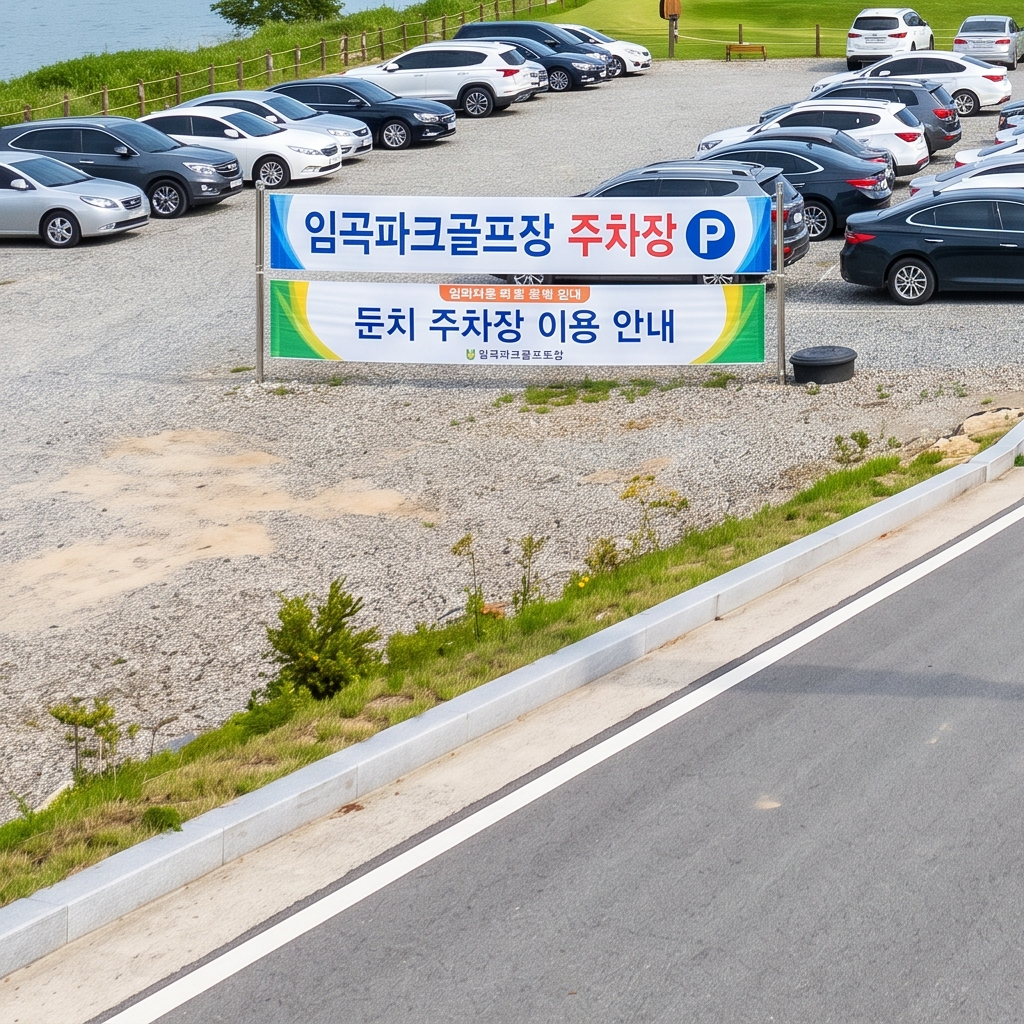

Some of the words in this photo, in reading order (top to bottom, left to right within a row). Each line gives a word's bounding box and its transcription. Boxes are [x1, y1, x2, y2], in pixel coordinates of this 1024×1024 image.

[304, 210, 555, 257] 임곡파크골프장
[567, 212, 678, 258] 주차장
[354, 307, 415, 341] 둔치
[428, 308, 525, 343] 주차장
[538, 309, 600, 344] 이용
[613, 308, 675, 344] 안내
